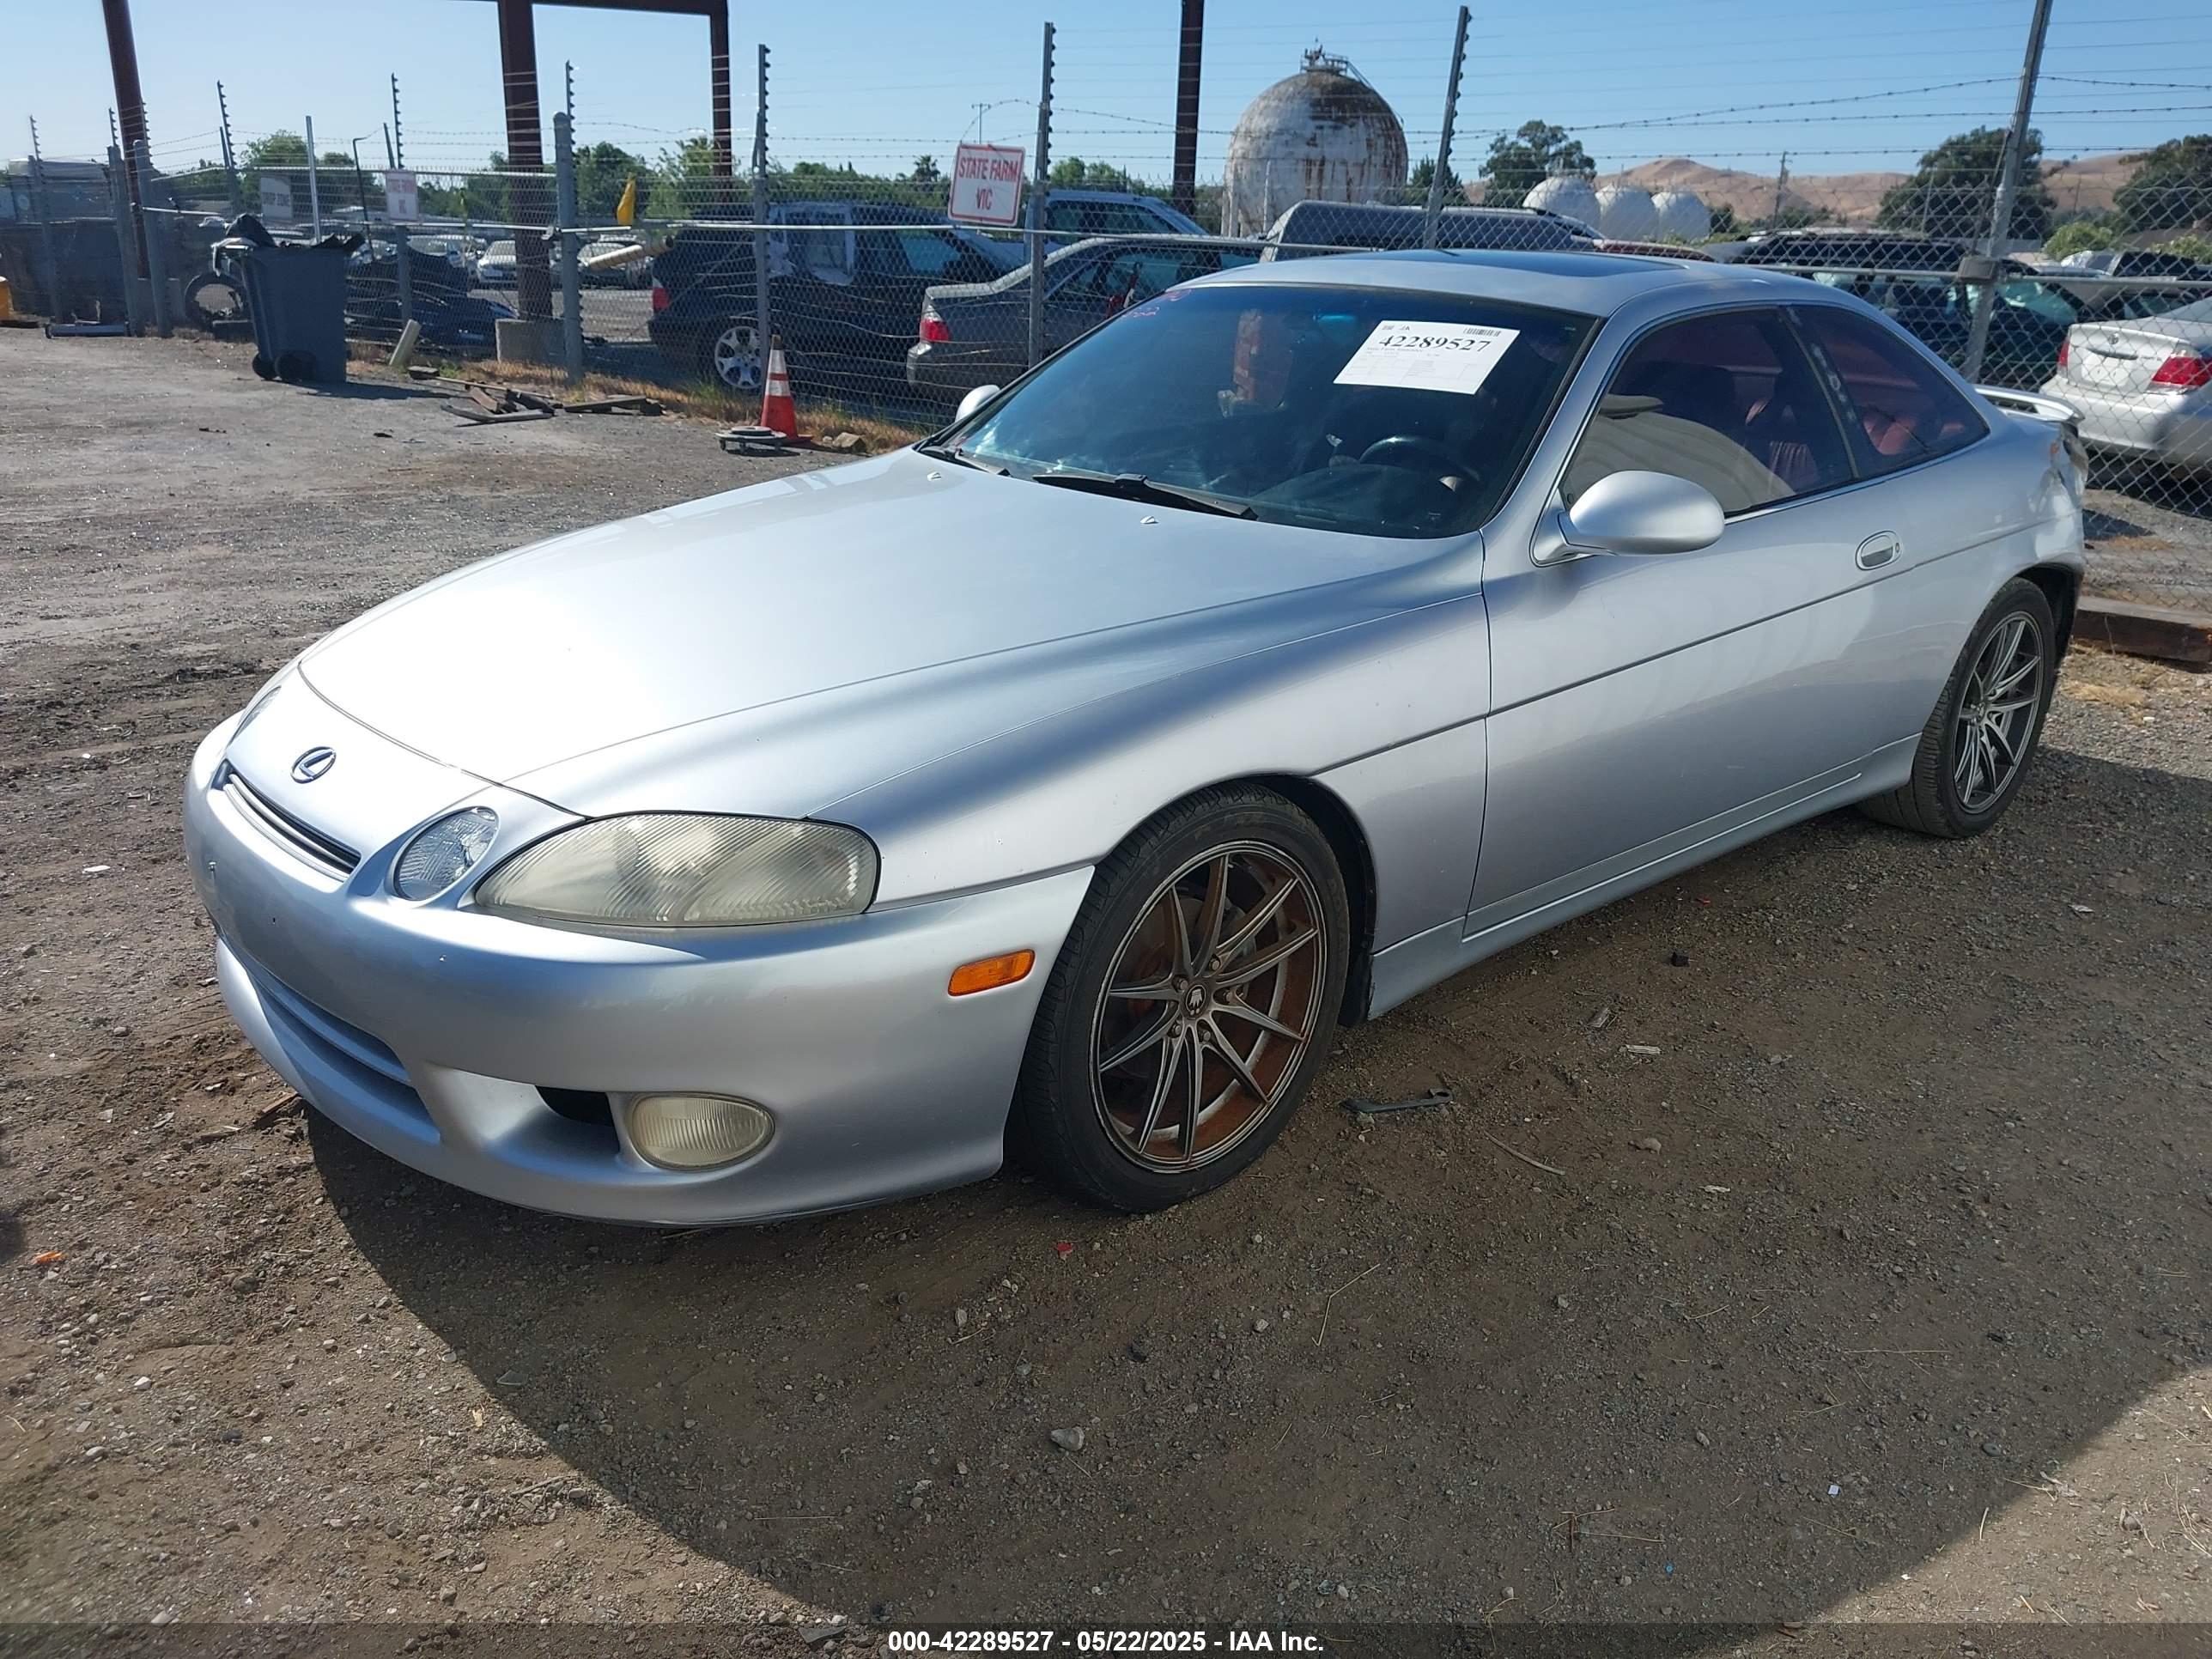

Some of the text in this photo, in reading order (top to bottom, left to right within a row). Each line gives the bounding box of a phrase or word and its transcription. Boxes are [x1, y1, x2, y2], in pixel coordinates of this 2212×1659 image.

[959, 156, 1018, 182] STATE FARM
[975, 187, 993, 210] VIC
[1379, 335, 1491, 352] 42289527
